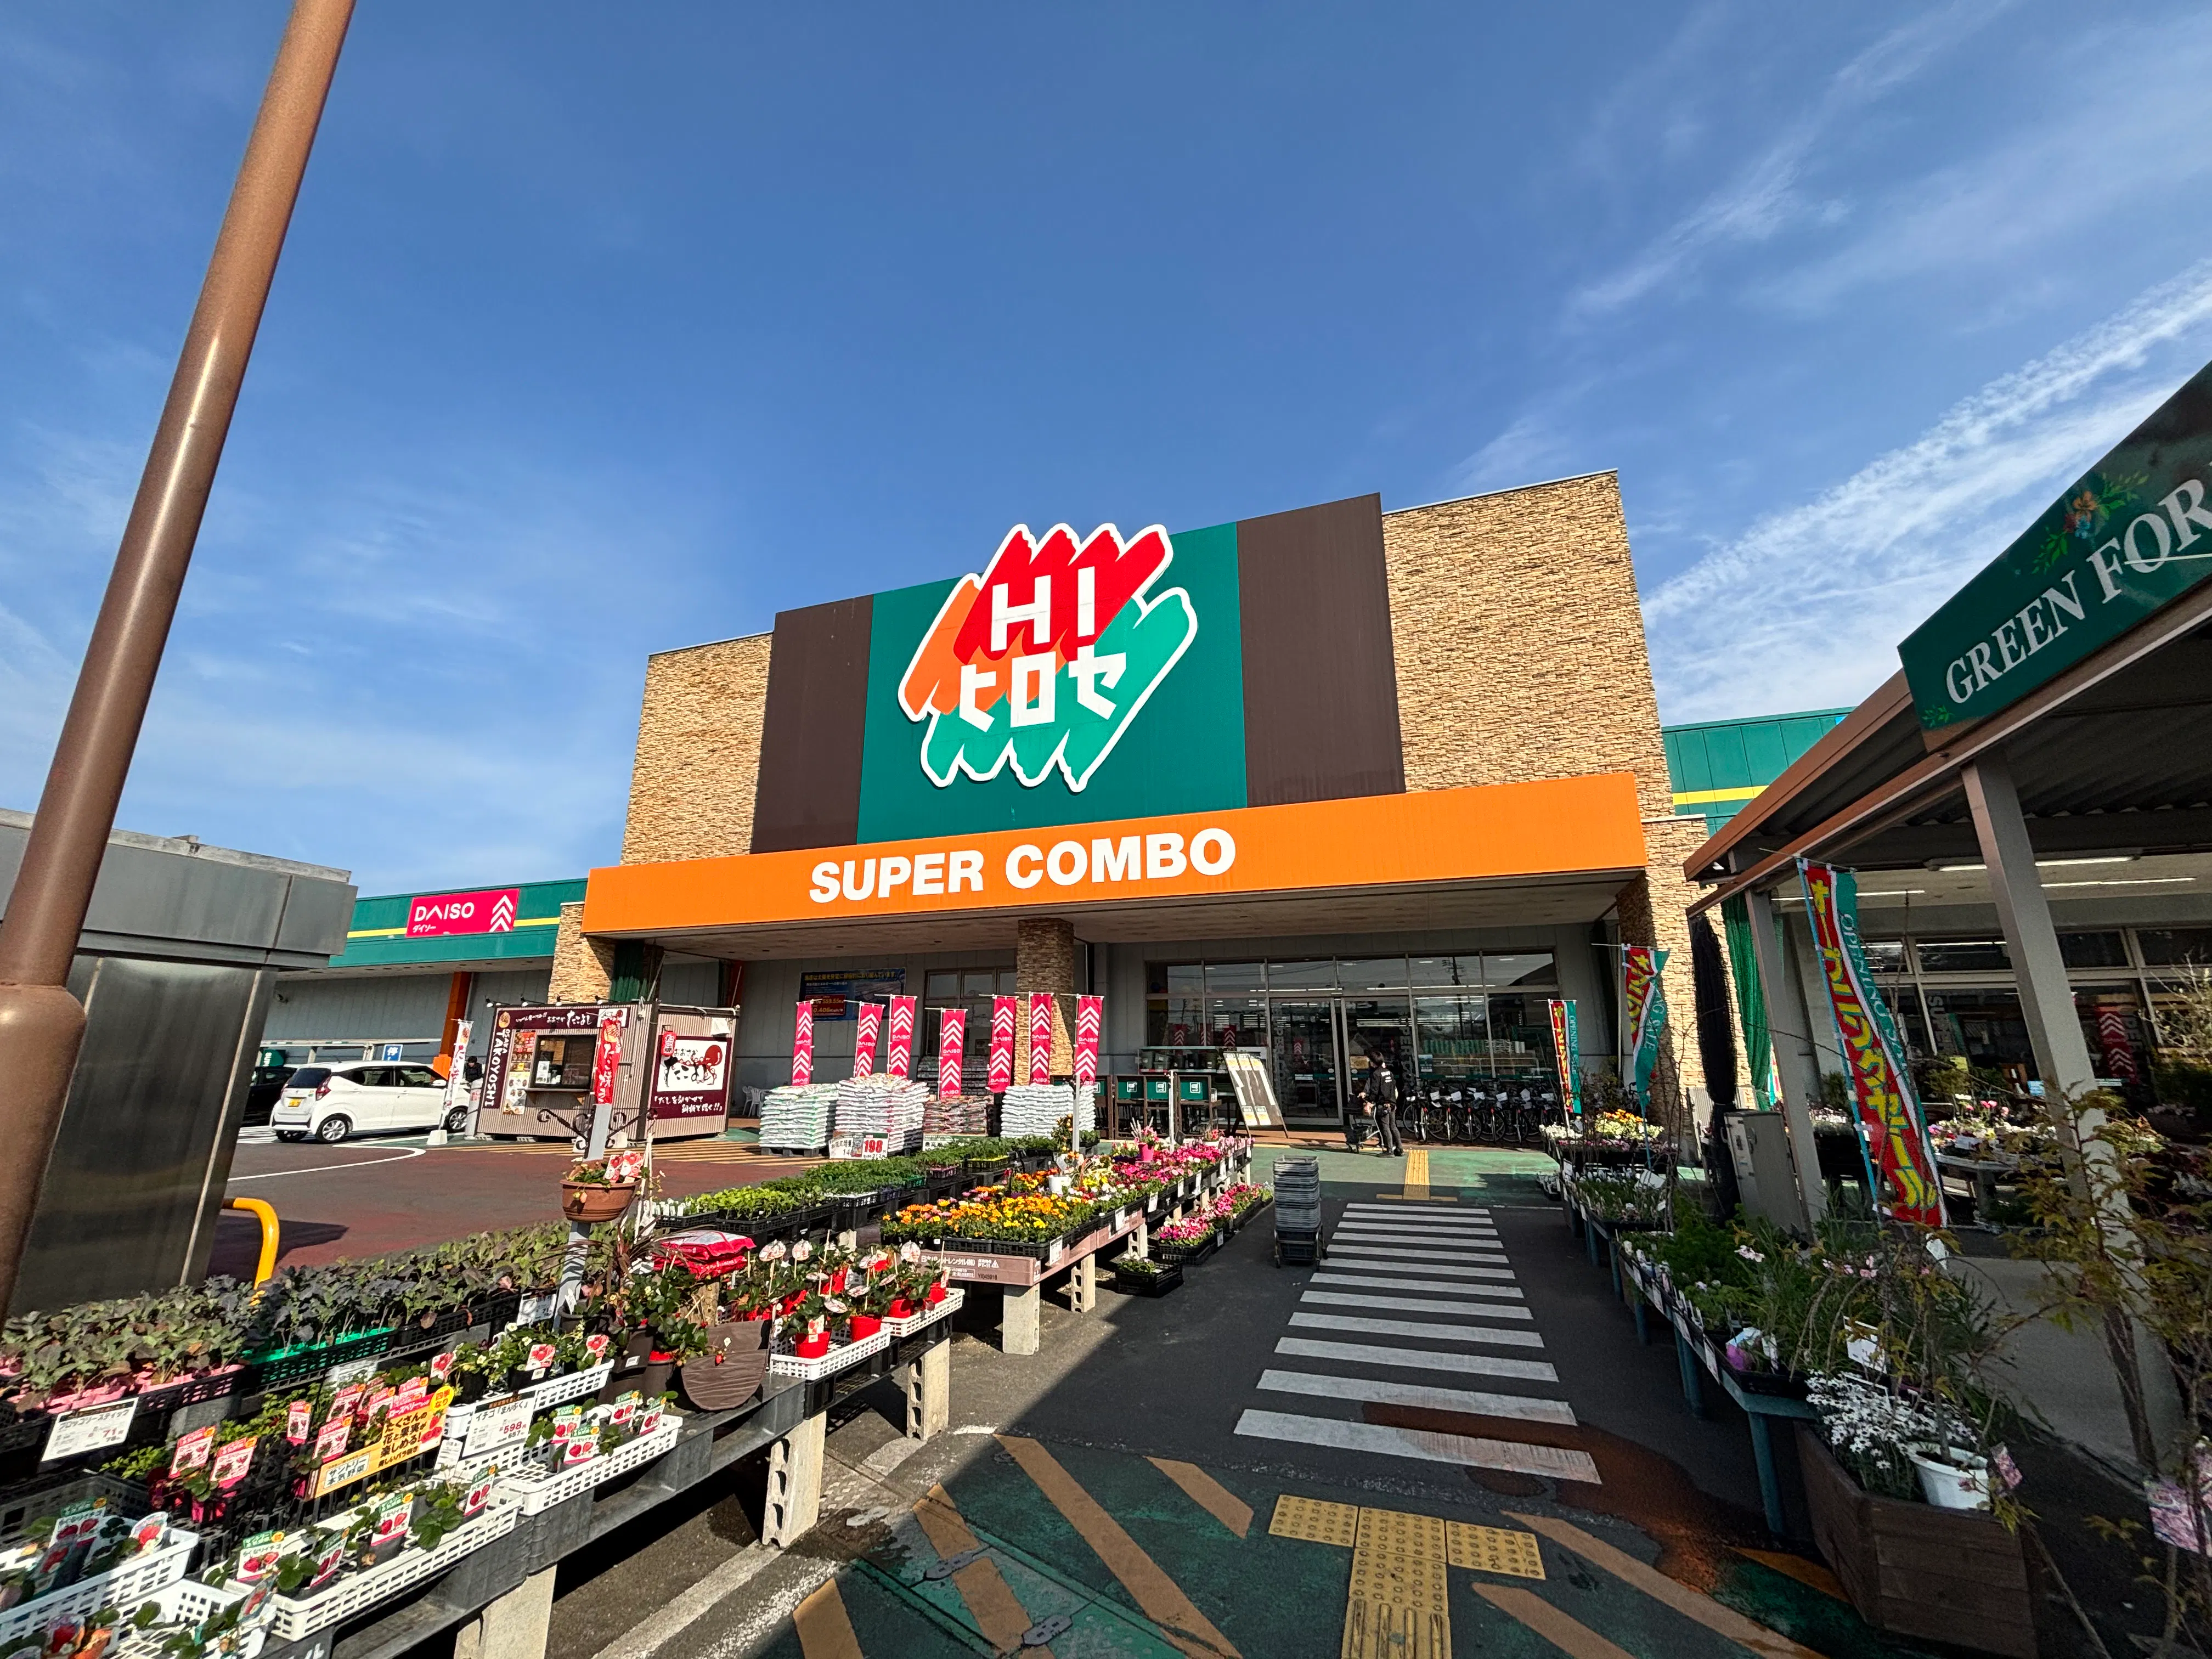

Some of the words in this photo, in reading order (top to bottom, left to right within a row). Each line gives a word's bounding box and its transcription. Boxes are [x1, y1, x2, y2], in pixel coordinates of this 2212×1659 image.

[1946, 569, 2085, 704] GREEN
[2086, 464, 2212, 604] FOR
[991, 566, 1096, 652] HI
[960, 646, 1127, 732] ヒロセ
[809, 850, 984, 903] SUPER
[1005, 828, 1236, 889] COMBO
[414, 902, 474, 922] DAISO
[413, 924, 436, 933] ダイソー
[567, 1010, 592, 1028] たこよし
[502, 1029, 511, 1054] OSAKA
[1569, 1015, 1577, 1051] OPENING
[263, 1052, 272, 1066] SUP
[485, 1029, 506, 1107] TAKOYOSHI
[434, 1398, 448, 1408] なり
[436, 1389, 450, 1400] 四季
[385, 1412, 427, 1432] たくさんの
[383, 1421, 427, 1445] 花と果実が
[329, 1459, 366, 1475] サントリー
[382, 1504, 410, 1519] くなりイチゴ
